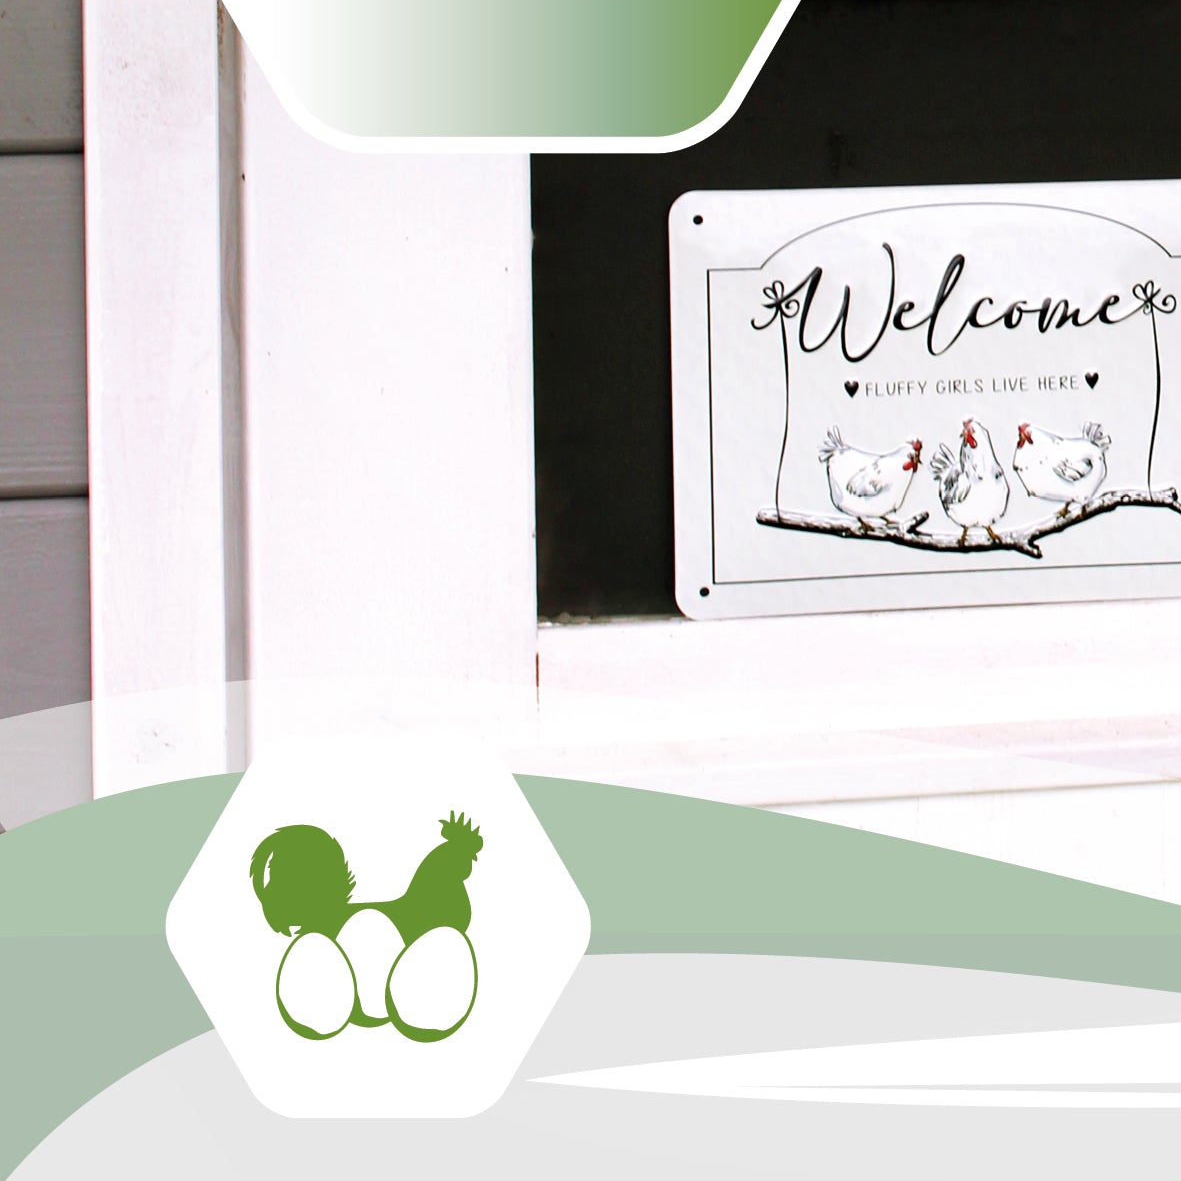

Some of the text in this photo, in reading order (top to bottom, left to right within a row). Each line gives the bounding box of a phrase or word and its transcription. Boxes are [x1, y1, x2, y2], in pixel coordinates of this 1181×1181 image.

[779, 242, 1141, 363] Welcome
[864, 373, 1080, 397] FLUFFY GIRLS LIVE HERE
